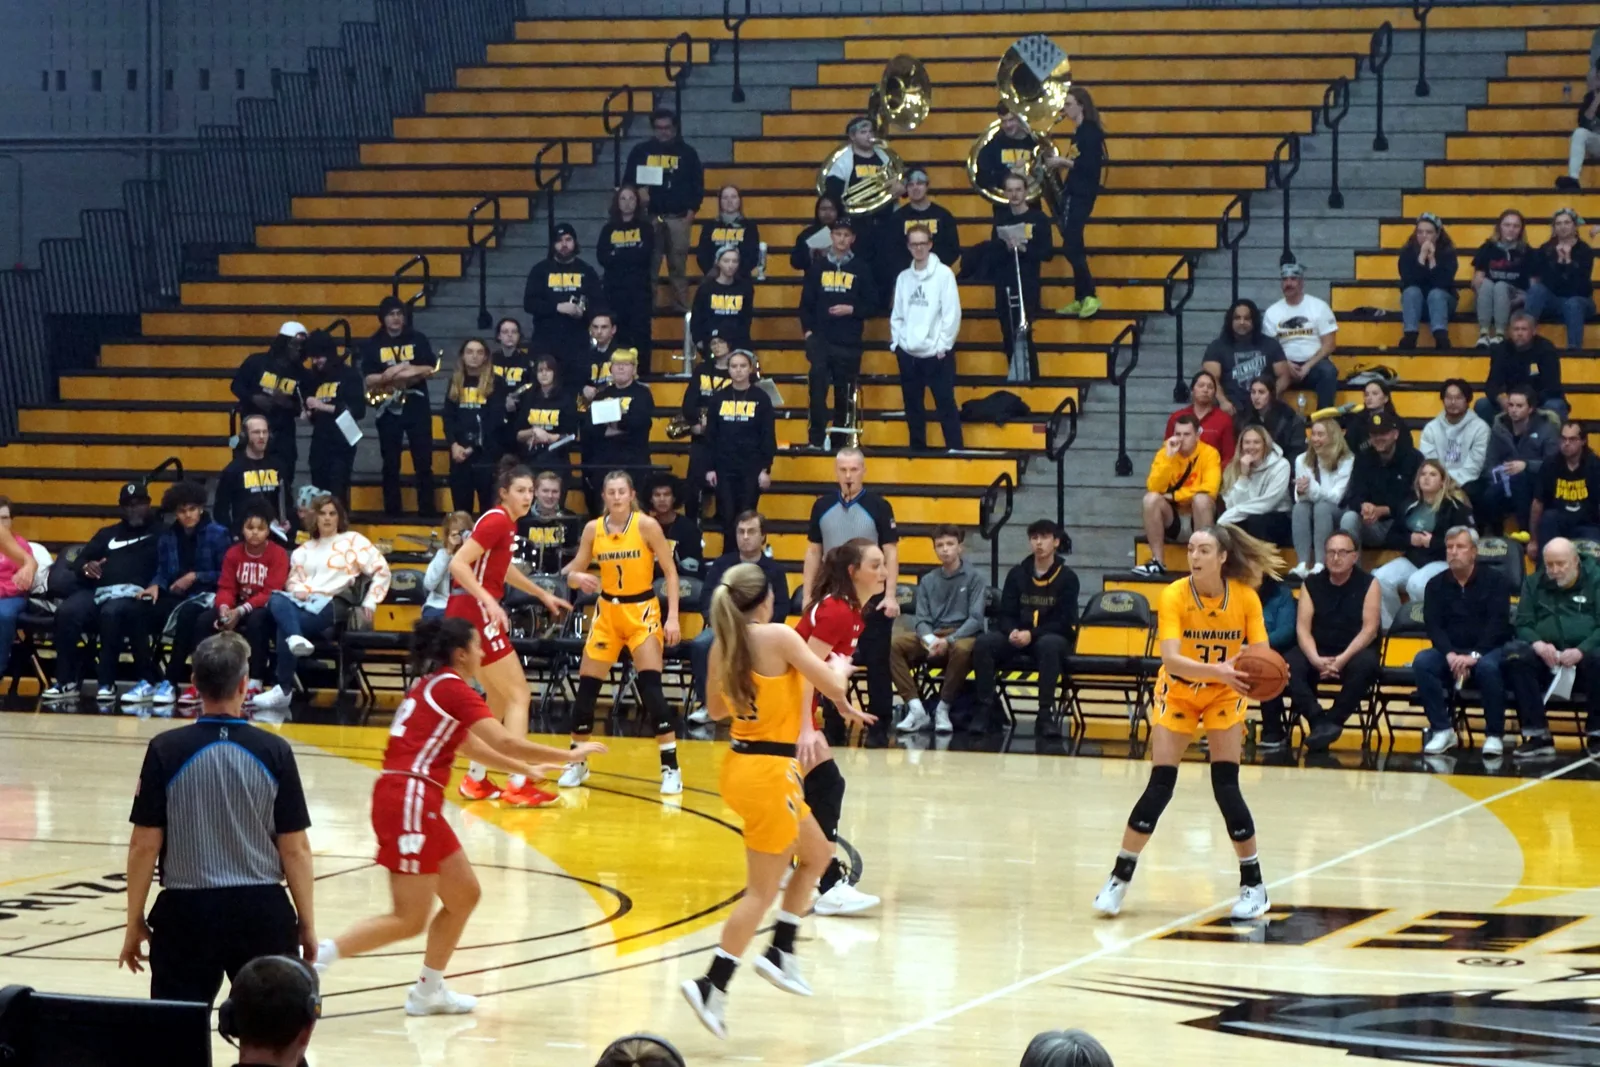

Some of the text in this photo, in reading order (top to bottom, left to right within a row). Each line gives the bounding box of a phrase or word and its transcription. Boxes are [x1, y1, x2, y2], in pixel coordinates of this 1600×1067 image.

[548, 273, 582, 287] MKE
[822, 271, 854, 289] MKE
[711, 295, 743, 310] MKE
[719, 400, 756, 417] MKE
[528, 409, 560, 426] MKE
[244, 469, 279, 489] MKE
[597, 550, 641, 560] MILWAUKEE
[615, 564, 623, 590] 1
[1183, 630, 1242, 640] MILWAUKEE
[1195, 643, 1228, 664] 33
